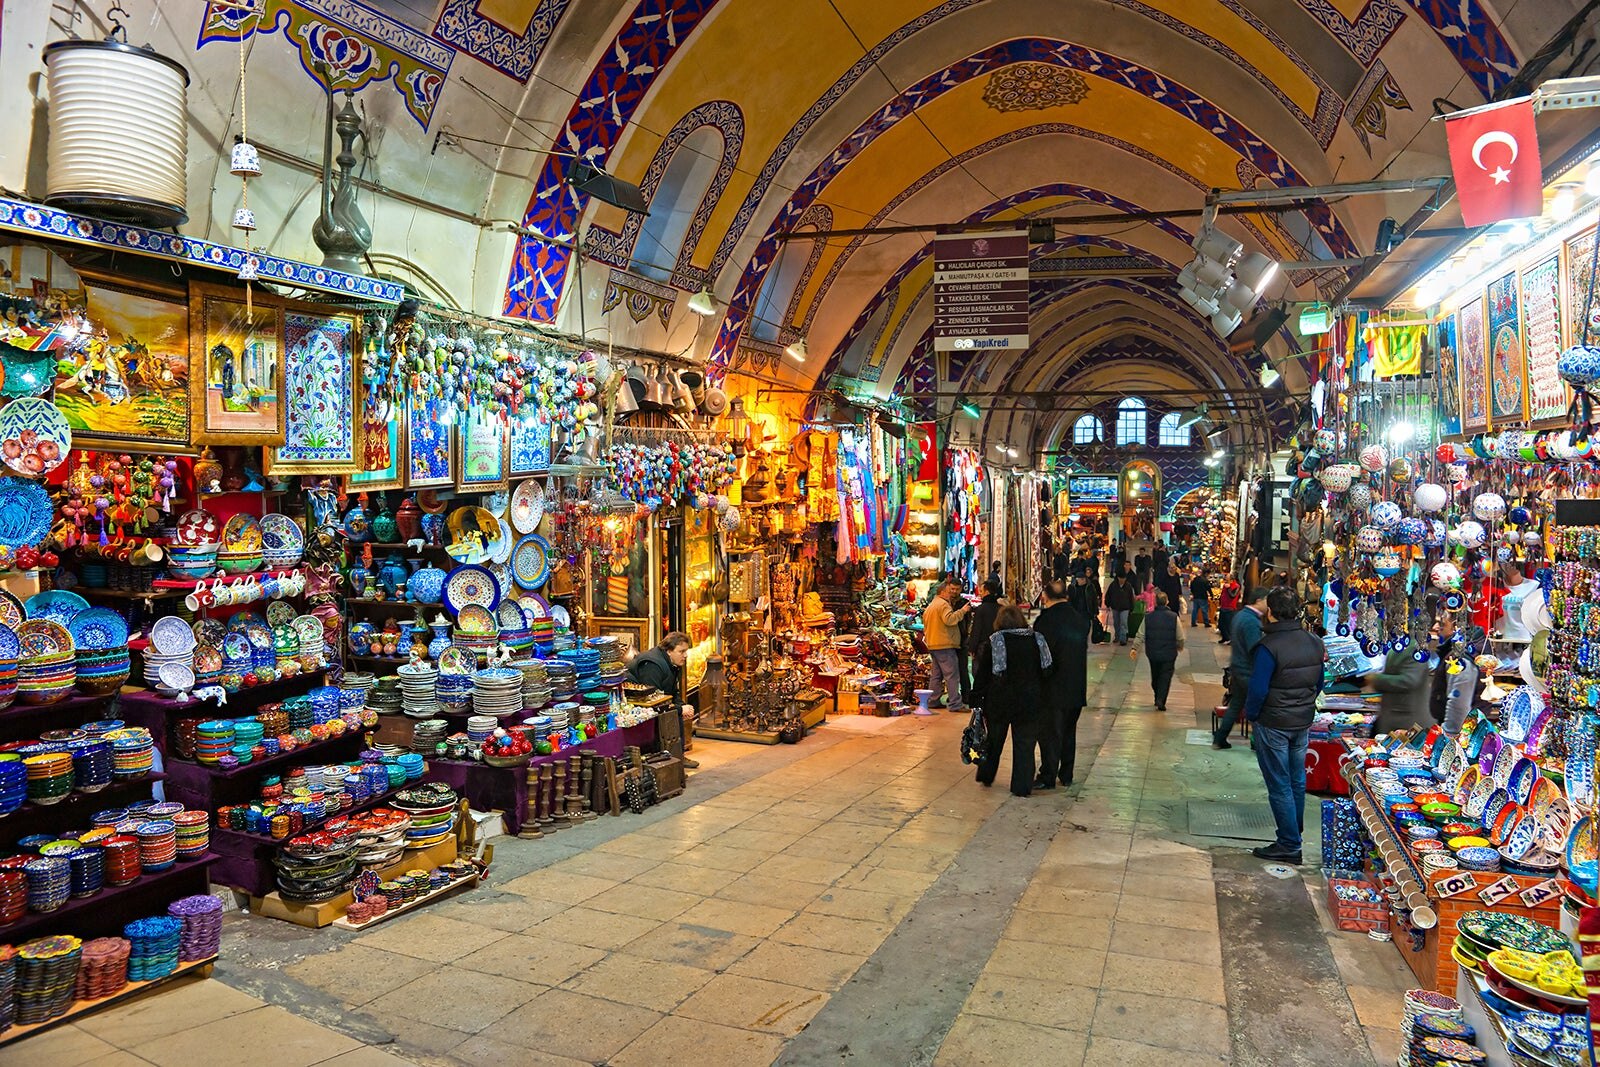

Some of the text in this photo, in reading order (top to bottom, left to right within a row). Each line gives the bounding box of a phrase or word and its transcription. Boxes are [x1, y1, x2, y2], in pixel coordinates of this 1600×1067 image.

[948, 262, 976, 270] HALICILAR
[998, 260, 1007, 268] SK.
[948, 273, 984, 281] MAHMUTPAŞA
[948, 294, 981, 302] TAKKECİLER
[948, 316, 981, 324] ZENNECİLER
[1491, 882, 1511, 897] 7
[1533, 887, 1551, 902] 4
